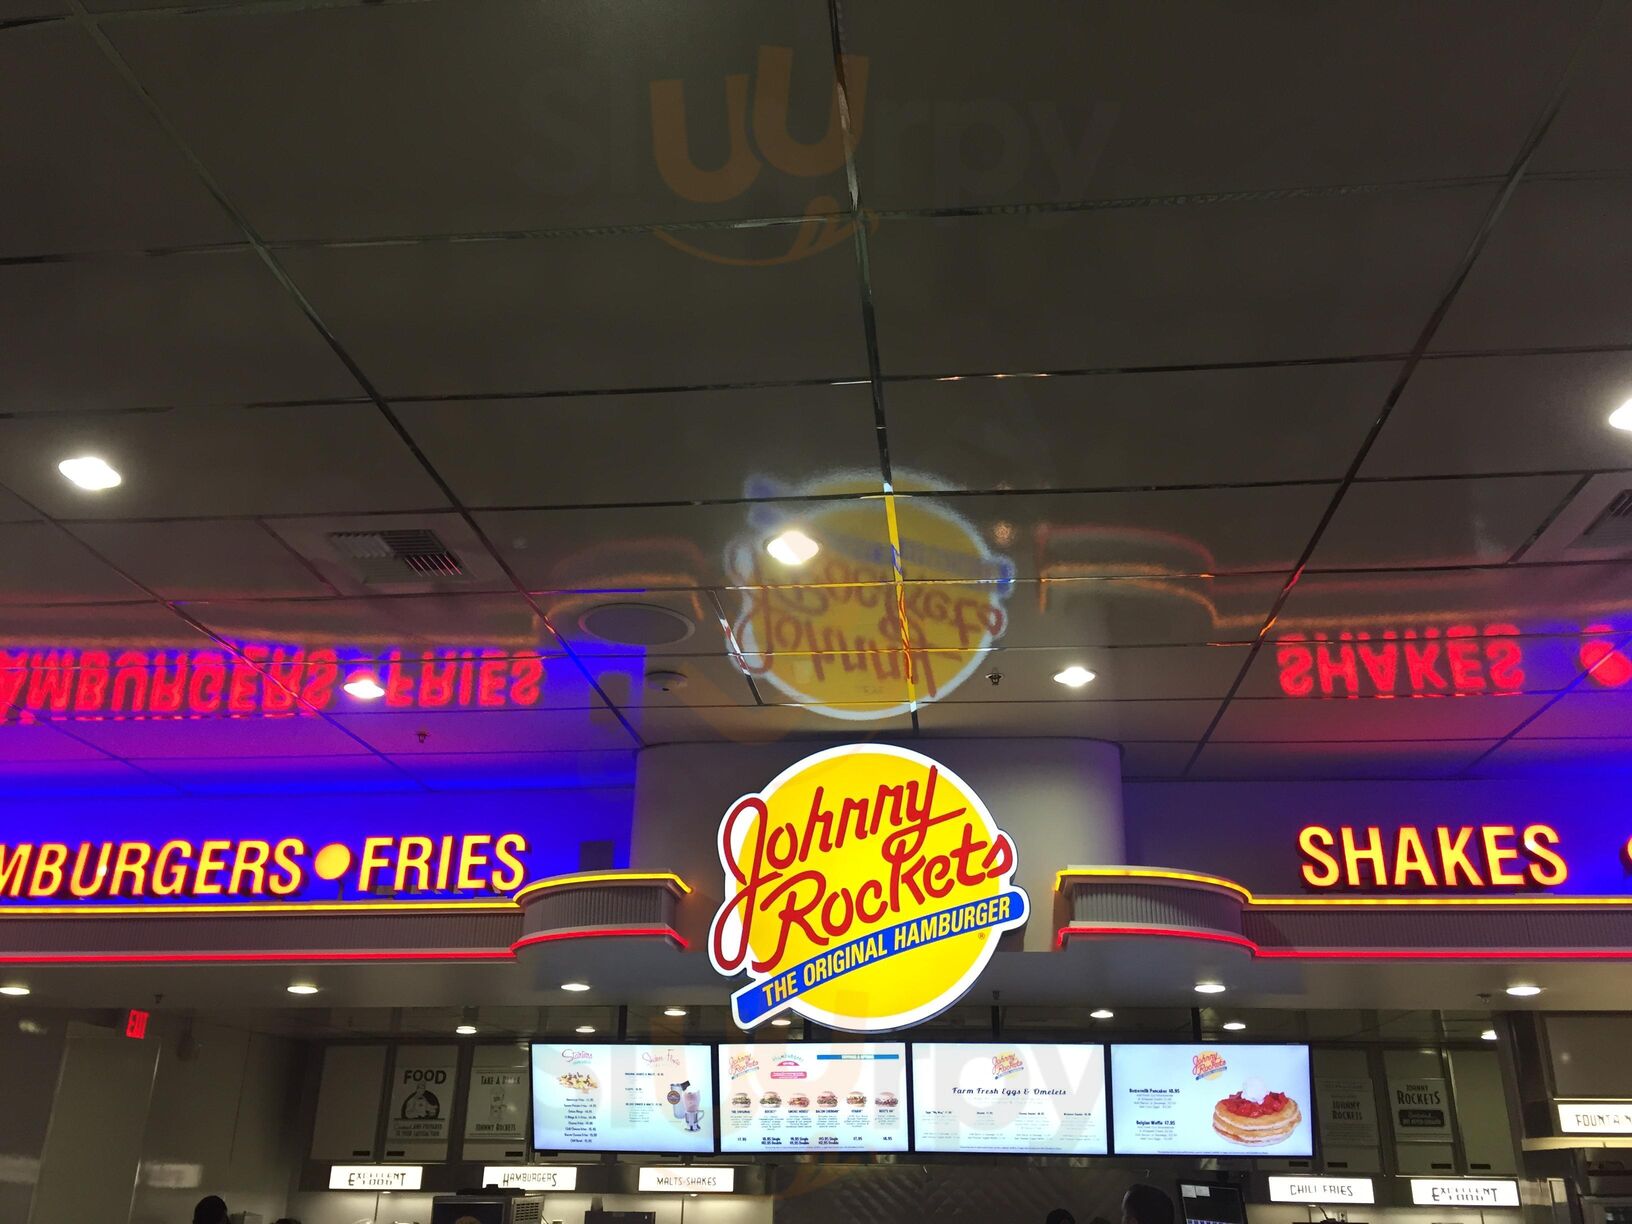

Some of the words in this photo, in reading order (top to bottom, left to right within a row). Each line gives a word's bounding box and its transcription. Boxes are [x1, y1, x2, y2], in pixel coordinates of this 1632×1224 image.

[358, 834, 529, 892] FRIES
[1298, 824, 1569, 887] SHAKES
[713, 764, 967, 971] Johnny
[751, 822, 1014, 973] Rockets
[762, 971, 799, 1007] THE
[803, 933, 888, 987] ORIGINAL
[894, 895, 1011, 950] HAMBURGER
[403, 1069, 447, 1085] FOOD
[495, 1075, 500, 1085] A
[951, 1087, 974, 1095] Farm
[977, 1087, 999, 1095] Fresh
[1001, 1087, 1021, 1097] Eggs
[1033, 1088, 1067, 1096] Omelets
[1396, 1089, 1441, 1105] ROCKETS
[1332, 1110, 1363, 1121] ROCKETS
[1575, 1114, 1632, 1127] FOUNTAN
[502, 1172, 558, 1187] HAMBURGERS
[1322, 1184, 1354, 1197] FRIES
